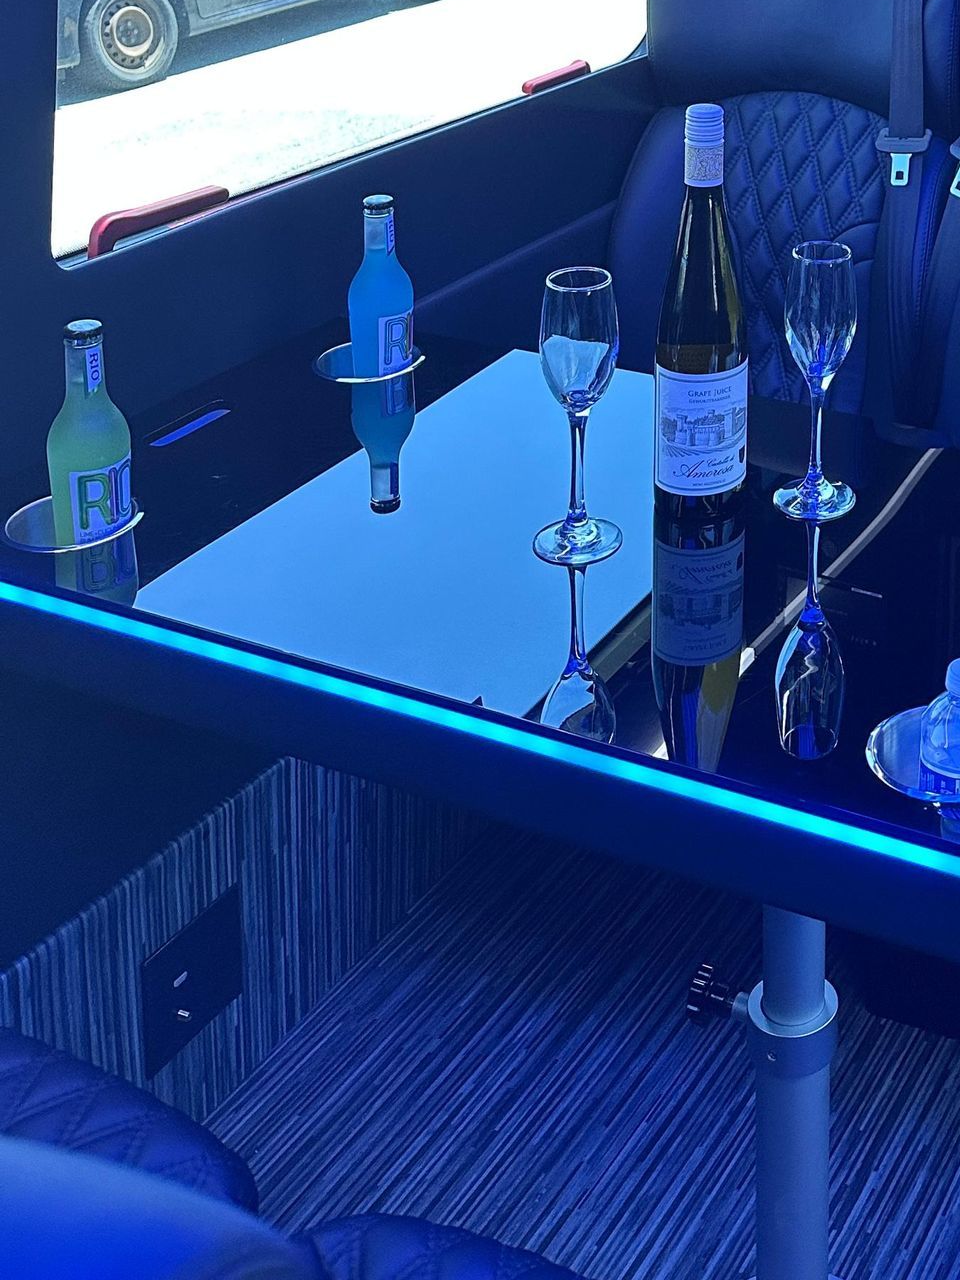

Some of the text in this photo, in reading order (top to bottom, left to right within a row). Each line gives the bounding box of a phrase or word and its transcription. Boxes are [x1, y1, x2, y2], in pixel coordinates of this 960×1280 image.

[89, 352, 100, 382] RIO
[687, 385, 733, 398] GRAPE JUICE
[673, 460, 734, 478] Amorosa
